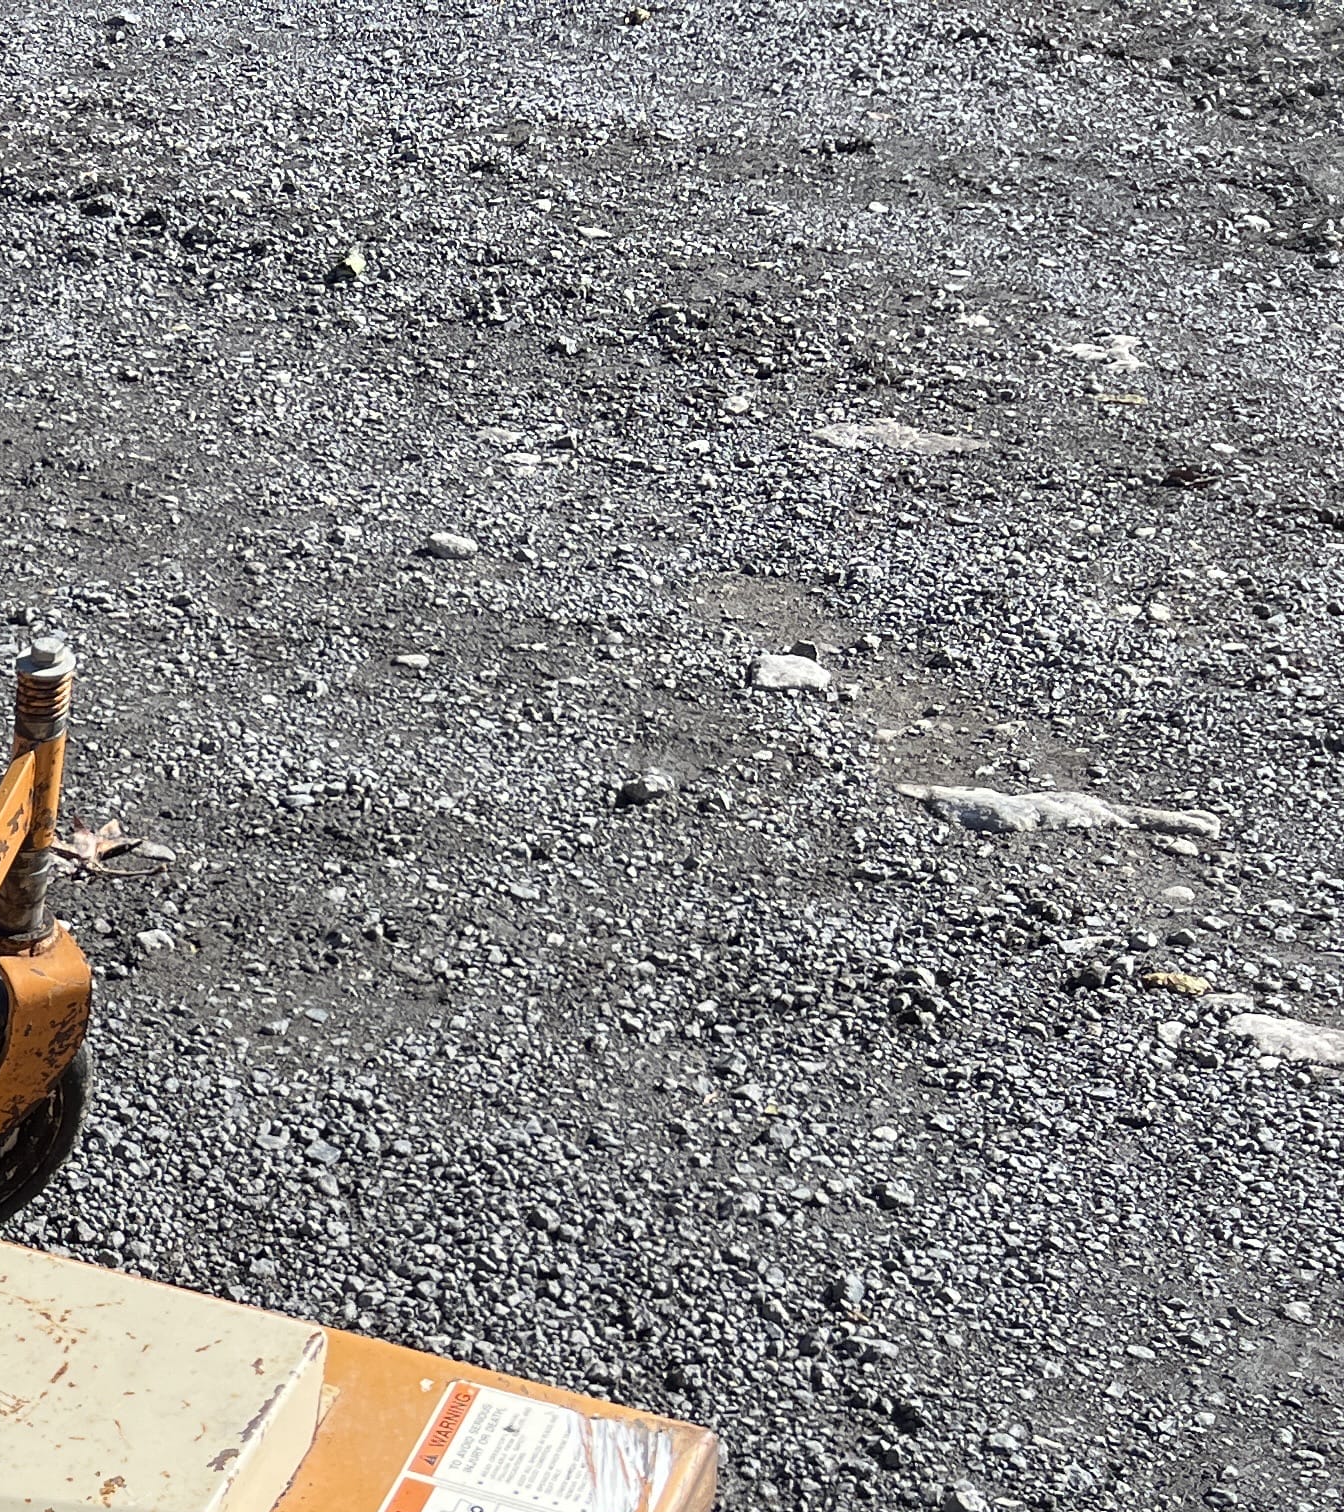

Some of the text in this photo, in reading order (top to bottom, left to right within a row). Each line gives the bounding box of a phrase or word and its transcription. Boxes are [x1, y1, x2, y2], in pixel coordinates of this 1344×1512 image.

[427, 1391, 472, 1447] WARNING
[454, 1435, 476, 1459] AVOID
[447, 1458, 463, 1470] TO
